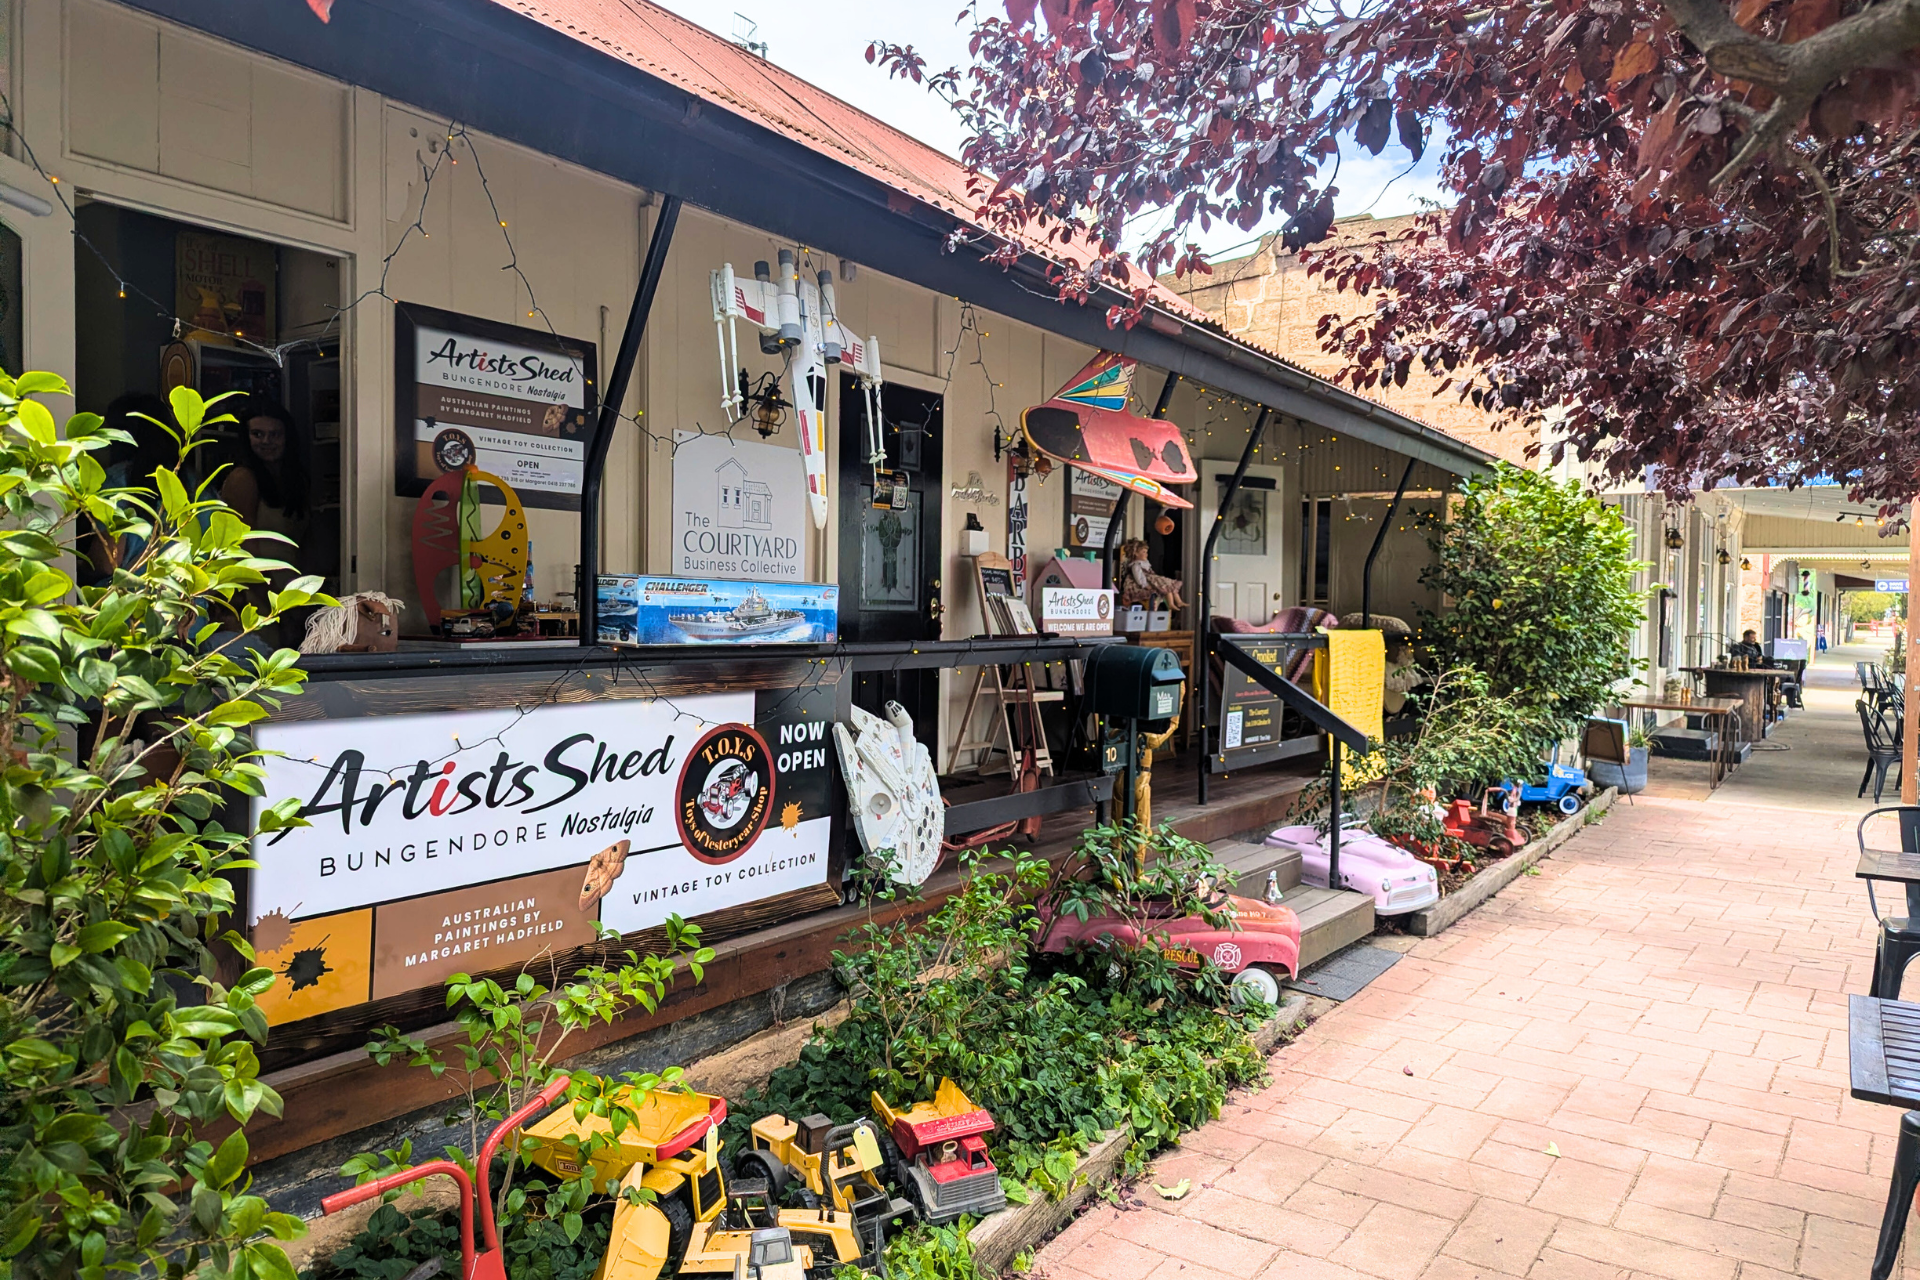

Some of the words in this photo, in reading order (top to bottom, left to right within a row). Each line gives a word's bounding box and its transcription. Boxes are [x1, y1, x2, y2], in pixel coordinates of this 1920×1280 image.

[185, 248, 255, 278] SHELL
[186, 273, 223, 285] MOTOR
[443, 372, 522, 392] BUNGENDORE
[527, 386, 566, 401] Nostalgia
[441, 396, 489, 409] AUSTRALIAN
[491, 404, 531, 415] PAINTINGS
[453, 407, 494, 419] MARGARET
[496, 414, 532, 424] HADFIELD
[479, 436, 511, 445] VINTAGE
[531, 443, 573, 453] COLLECTION
[517, 460, 540, 469] OPEN
[525, 478, 547, 486] Margaret
[685, 511, 710, 527] The
[1011, 466, 1027, 599] BARBE
[683, 530, 797, 559] COURTYARD
[684, 556, 737, 571] Business
[741, 559, 796, 574] Collective
[645, 581, 709, 593] CHALLENGER
[1048, 622, 1075, 631] WELCOME
[1076, 623, 1084, 631] WE
[1085, 623, 1096, 631] ARE
[1096, 622, 1110, 631] OPEN
[780, 721, 826, 745] NOW
[777, 748, 826, 773] OPEN
[1105, 746, 1117, 762] 10
[685, 798, 696, 831] Toys
[694, 829, 707, 843] of
[703, 821, 754, 851] Yesteryear
[751, 786, 768, 822] Shop
[320, 823, 547, 877] BUNGENDORE
[561, 804, 654, 838] Nostalgia
[633, 880, 698, 906] VINTAGE
[705, 872, 733, 888] TOY
[738, 852, 817, 880] COLLECTION
[442, 898, 536, 927] AUSTRALIAN
[434, 916, 517, 945] PAINTINGS
[524, 911, 541, 924] BY
[405, 937, 490, 967] MARGARET
[496, 920, 564, 945] HADFIELD
[1164, 948, 1200, 964] RESCUE
[559, 1161, 582, 1173] Tonk
